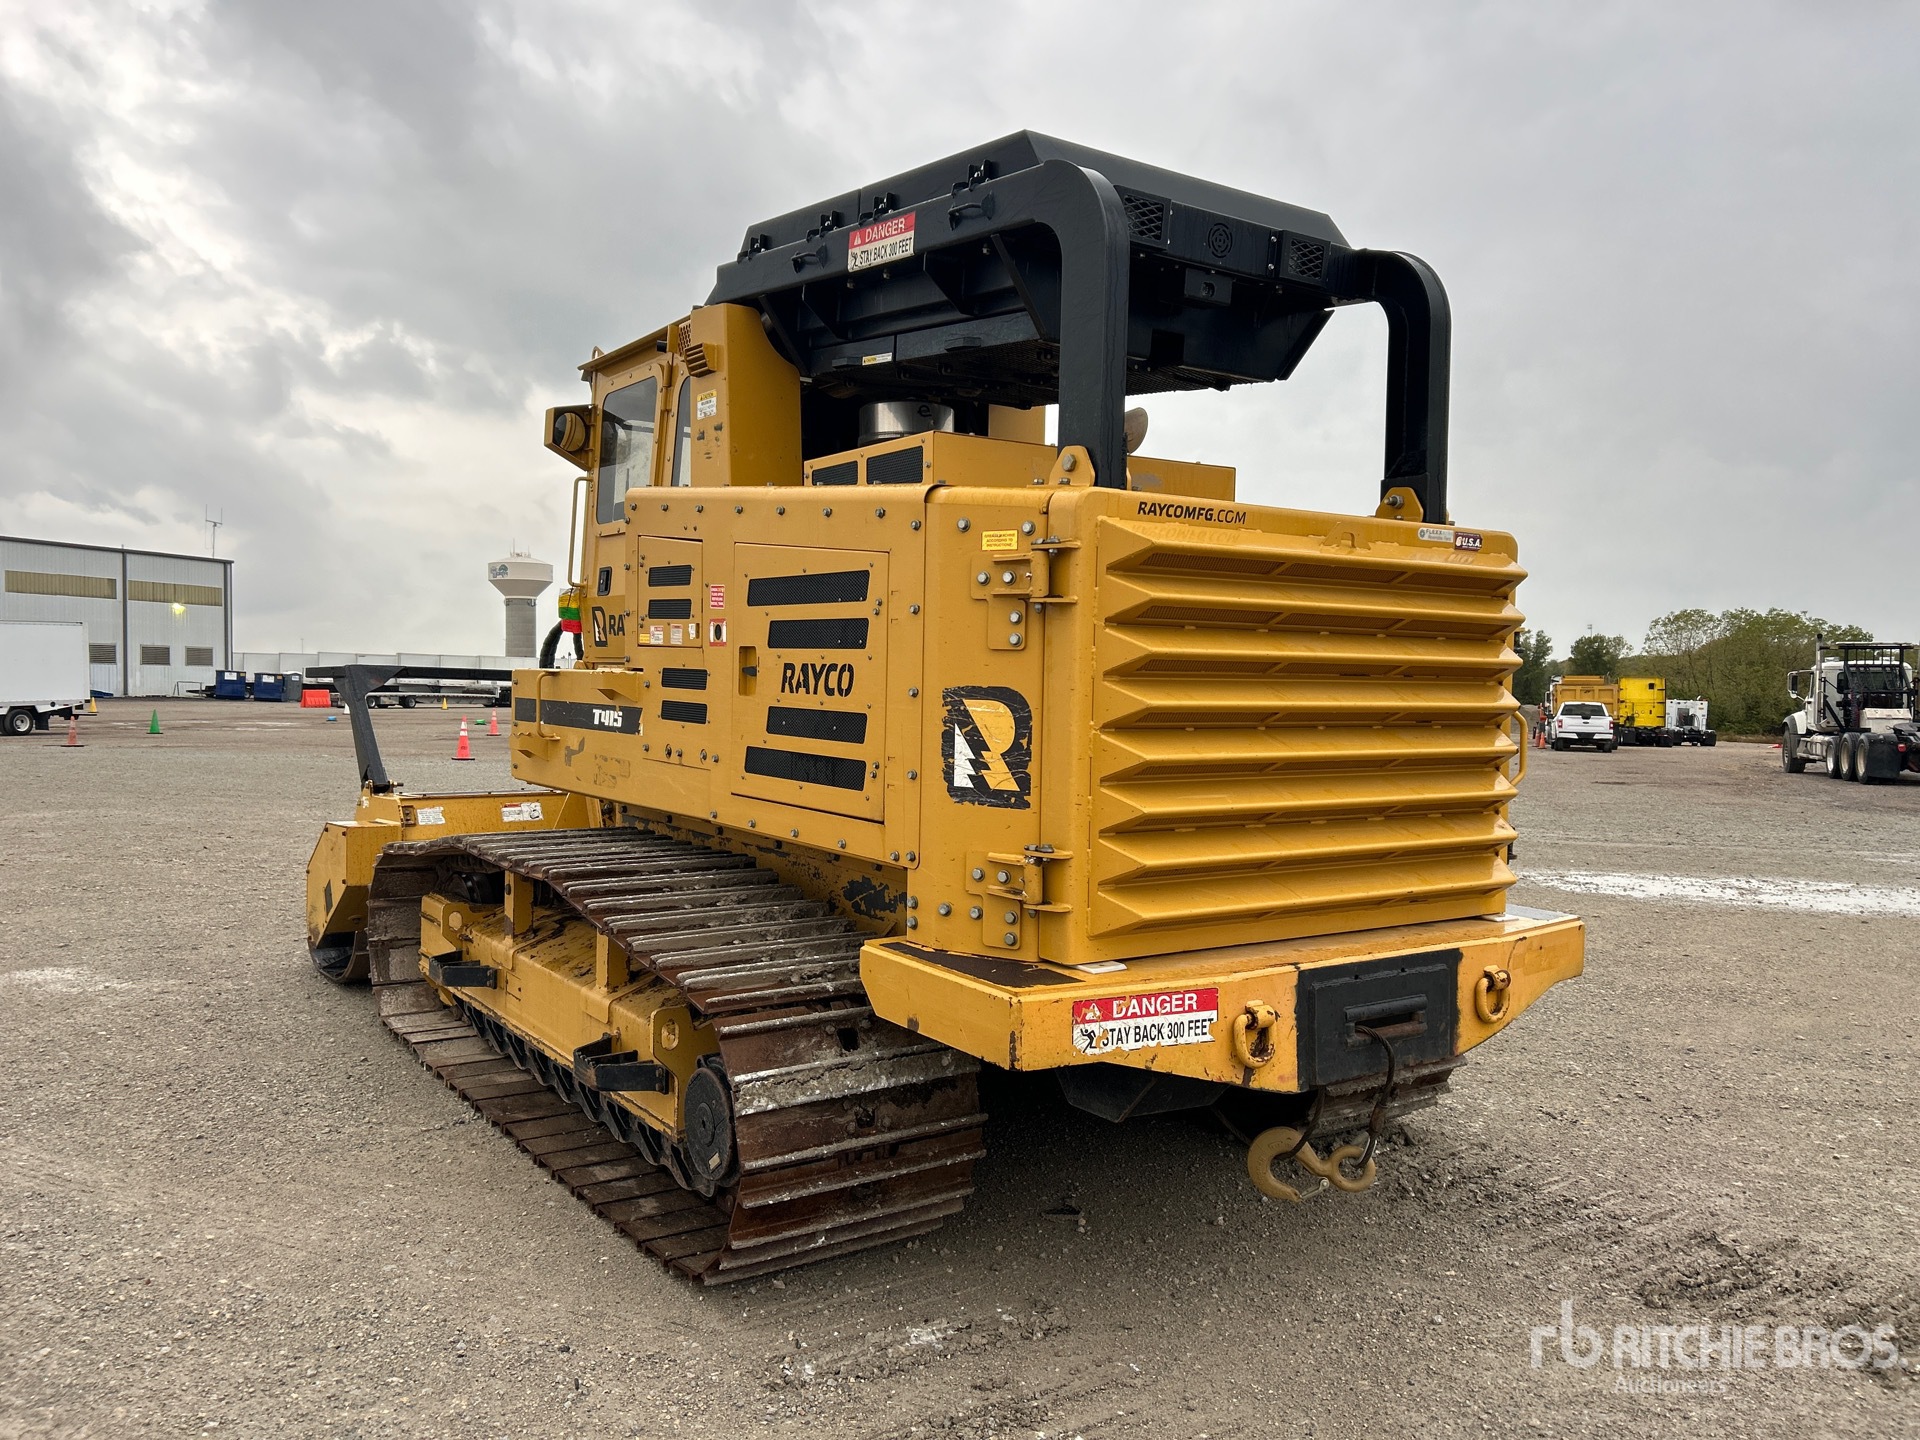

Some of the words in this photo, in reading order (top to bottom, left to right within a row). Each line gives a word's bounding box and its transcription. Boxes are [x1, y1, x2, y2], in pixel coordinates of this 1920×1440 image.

[865, 217, 906, 243] DANGER
[859, 248, 874, 266] STAY
[873, 243, 889, 261] BACK
[888, 241, 898, 257] 300
[898, 237, 913, 254] FEET
[1137, 501, 1247, 525] RAYCOMFG.COM
[780, 662, 855, 698] RAYCO
[592, 708, 623, 728] T415
[1112, 993, 1198, 1018] DANGER
[1134, 1022, 1165, 1043] BACK
[1167, 1021, 1185, 1039] 300
